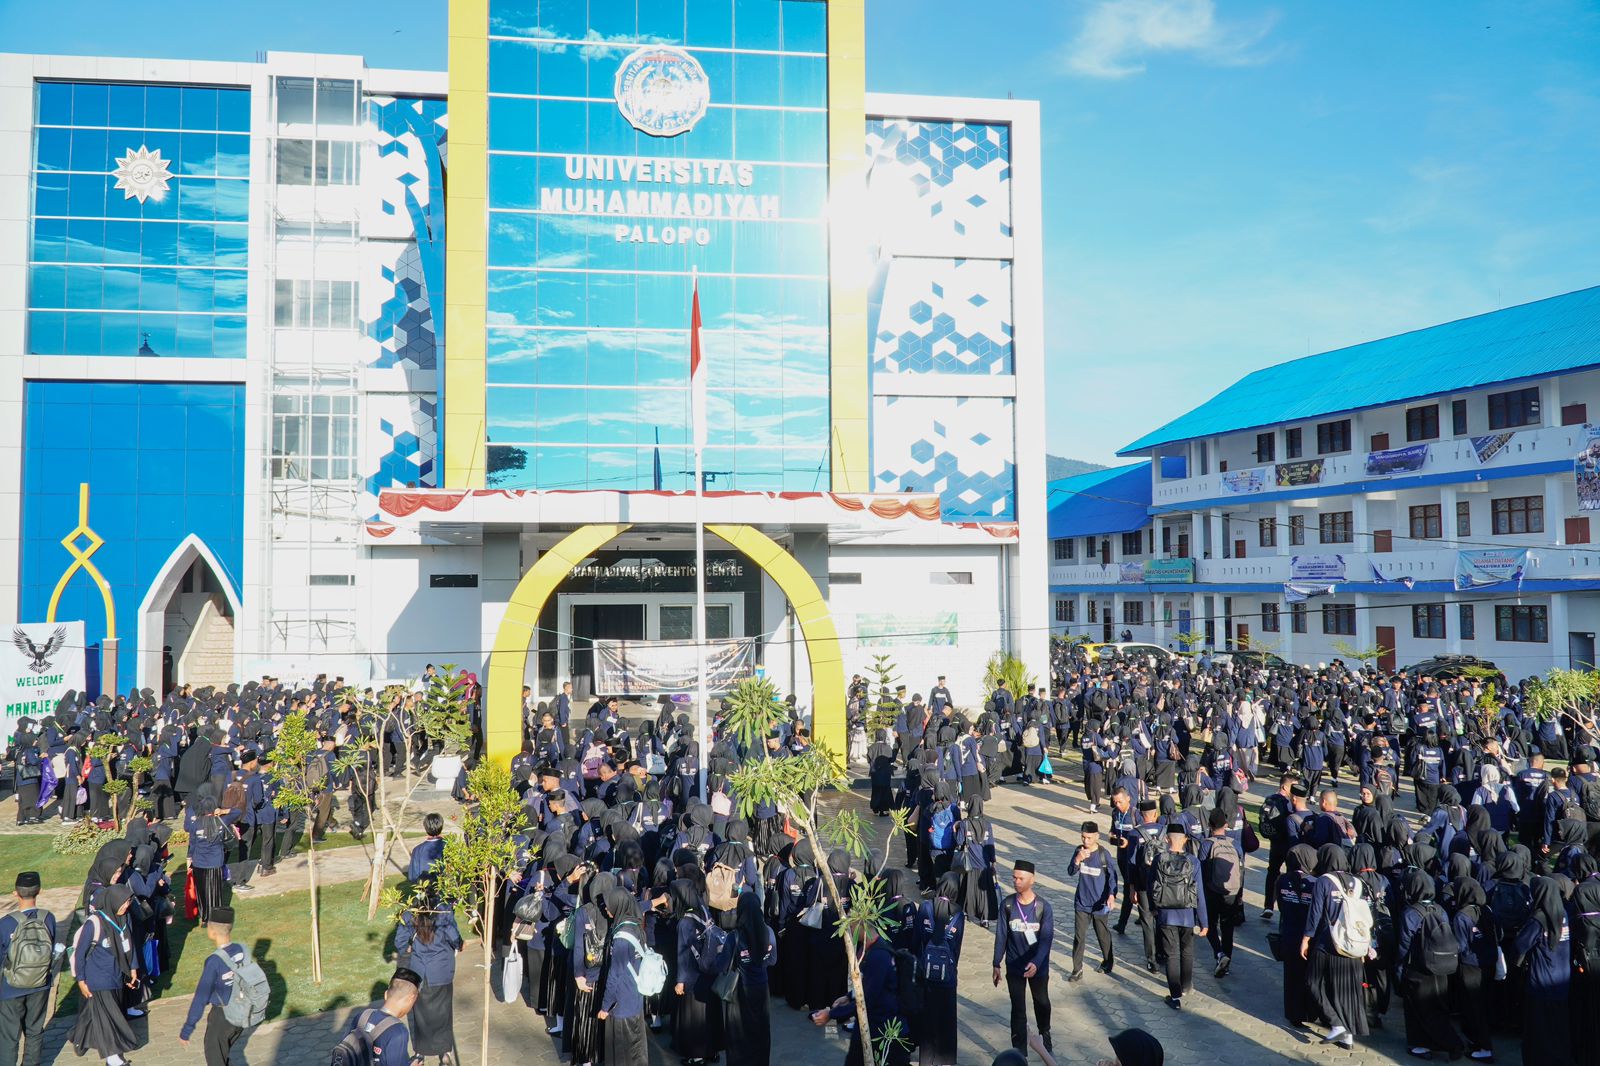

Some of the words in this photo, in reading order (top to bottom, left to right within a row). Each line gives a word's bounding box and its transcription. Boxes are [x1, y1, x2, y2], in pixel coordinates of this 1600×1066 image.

[565, 156, 754, 187] UNIVERSITAS
[541, 187, 780, 219] MUHAMMADIYAH
[615, 224, 711, 245] PALOPO
[570, 566, 639, 577] HAMMADIYAH
[641, 565, 697, 577] CONVENTIO
[705, 565, 743, 577] CENTRE
[16, 674, 64, 687] WELCOME
[6, 699, 61, 717] MANAJEM
